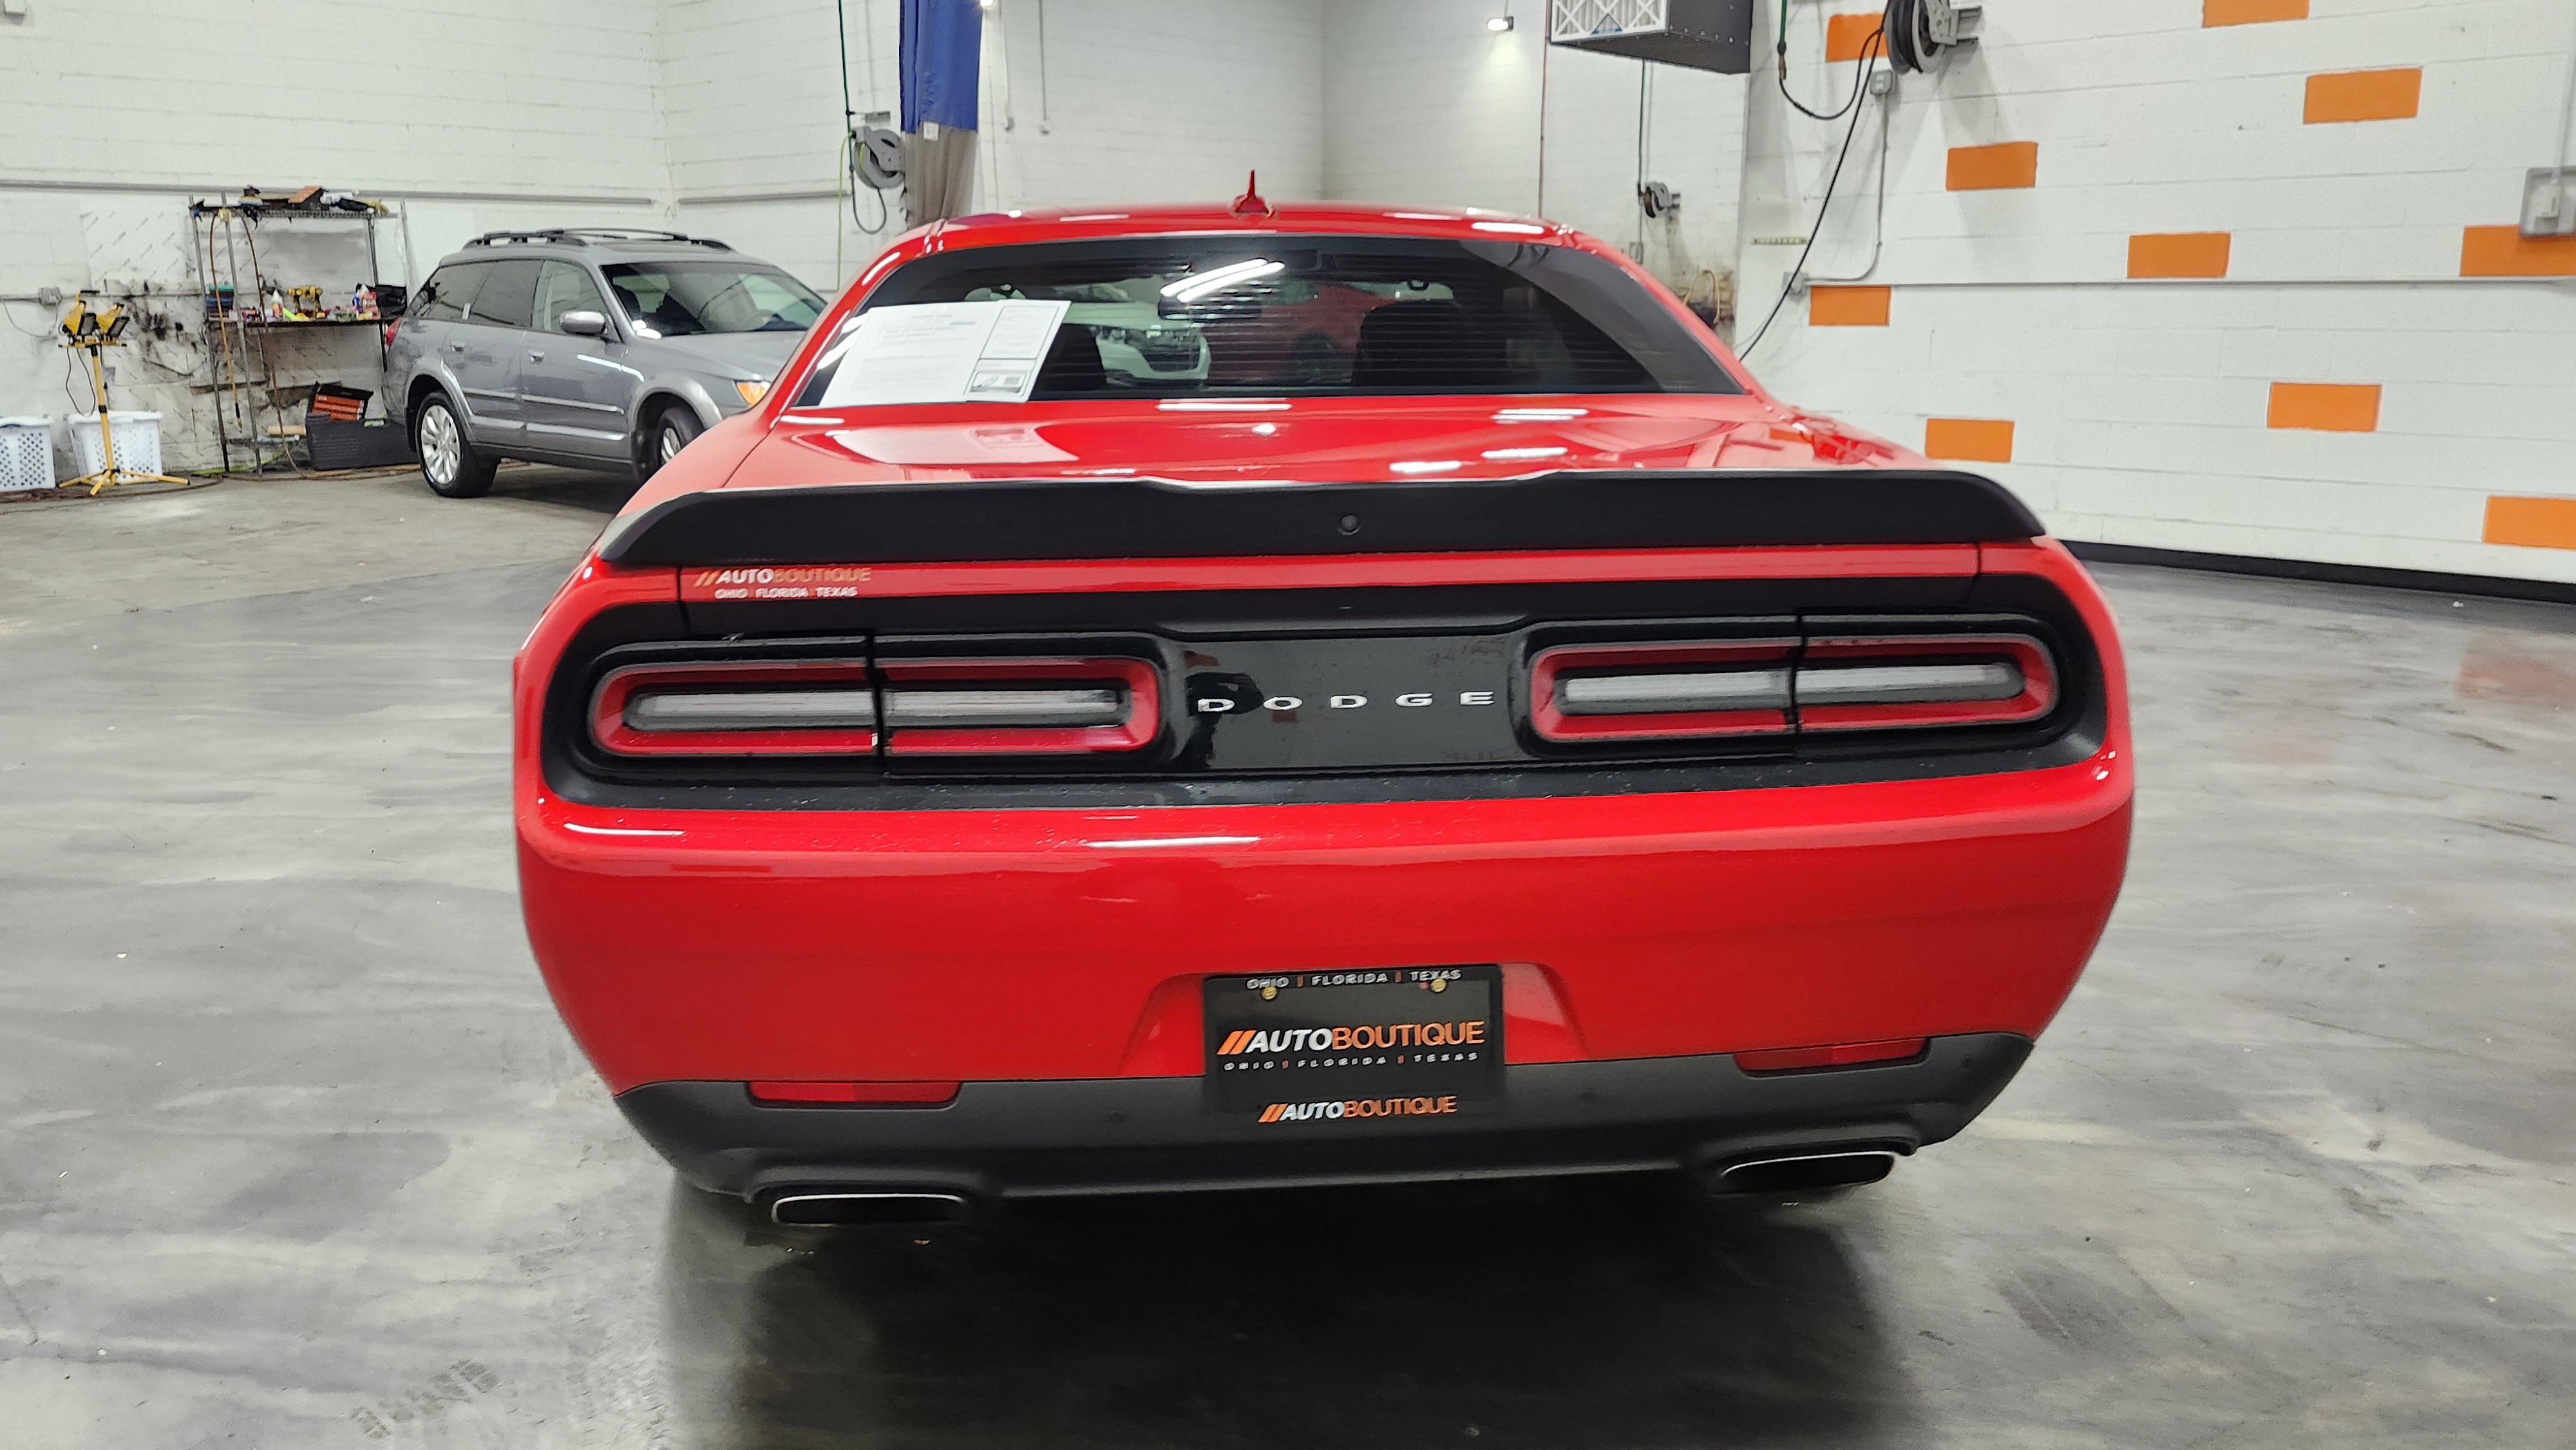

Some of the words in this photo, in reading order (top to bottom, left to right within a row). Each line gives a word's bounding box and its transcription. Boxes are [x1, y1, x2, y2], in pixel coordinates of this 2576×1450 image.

[715, 567, 871, 584] AUTOBOUTIQUE
[715, 587, 748, 599] OHIO
[755, 587, 809, 598] FLORIDA
[815, 587, 858, 597] TEXAS
[1197, 691, 1495, 712] DODGE
[1246, 977, 1289, 990] OHIO
[1311, 972, 1388, 986] FLORIDA
[1409, 969, 1461, 982] TEXAS
[1245, 1021, 1485, 1053] AUTOBOUTIQUE
[1224, 1060, 1274, 1071] OHIO
[1297, 1057, 1387, 1068] FLORIDA
[1414, 1052, 1477, 1063] TEXAS
[1279, 1096, 1457, 1121] AUTOBOUTIQUE
